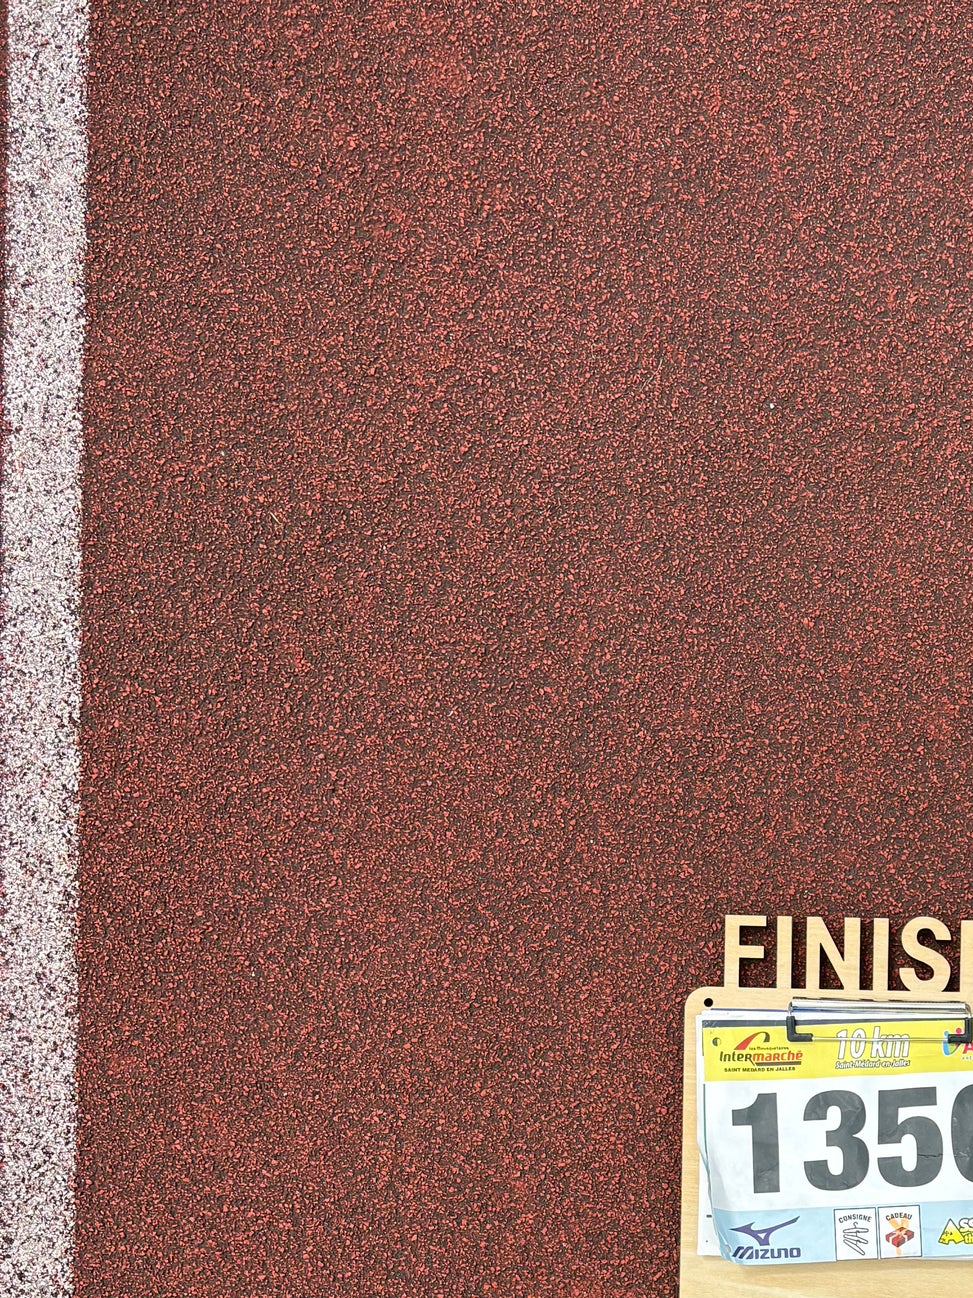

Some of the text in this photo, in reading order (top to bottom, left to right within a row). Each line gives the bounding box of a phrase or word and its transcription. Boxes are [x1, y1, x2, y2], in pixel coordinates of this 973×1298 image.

[836, 1026, 910, 1060] 10 km
[838, 1214, 872, 1224] CONSIGNE
[885, 1212, 912, 1221] CADEAU
